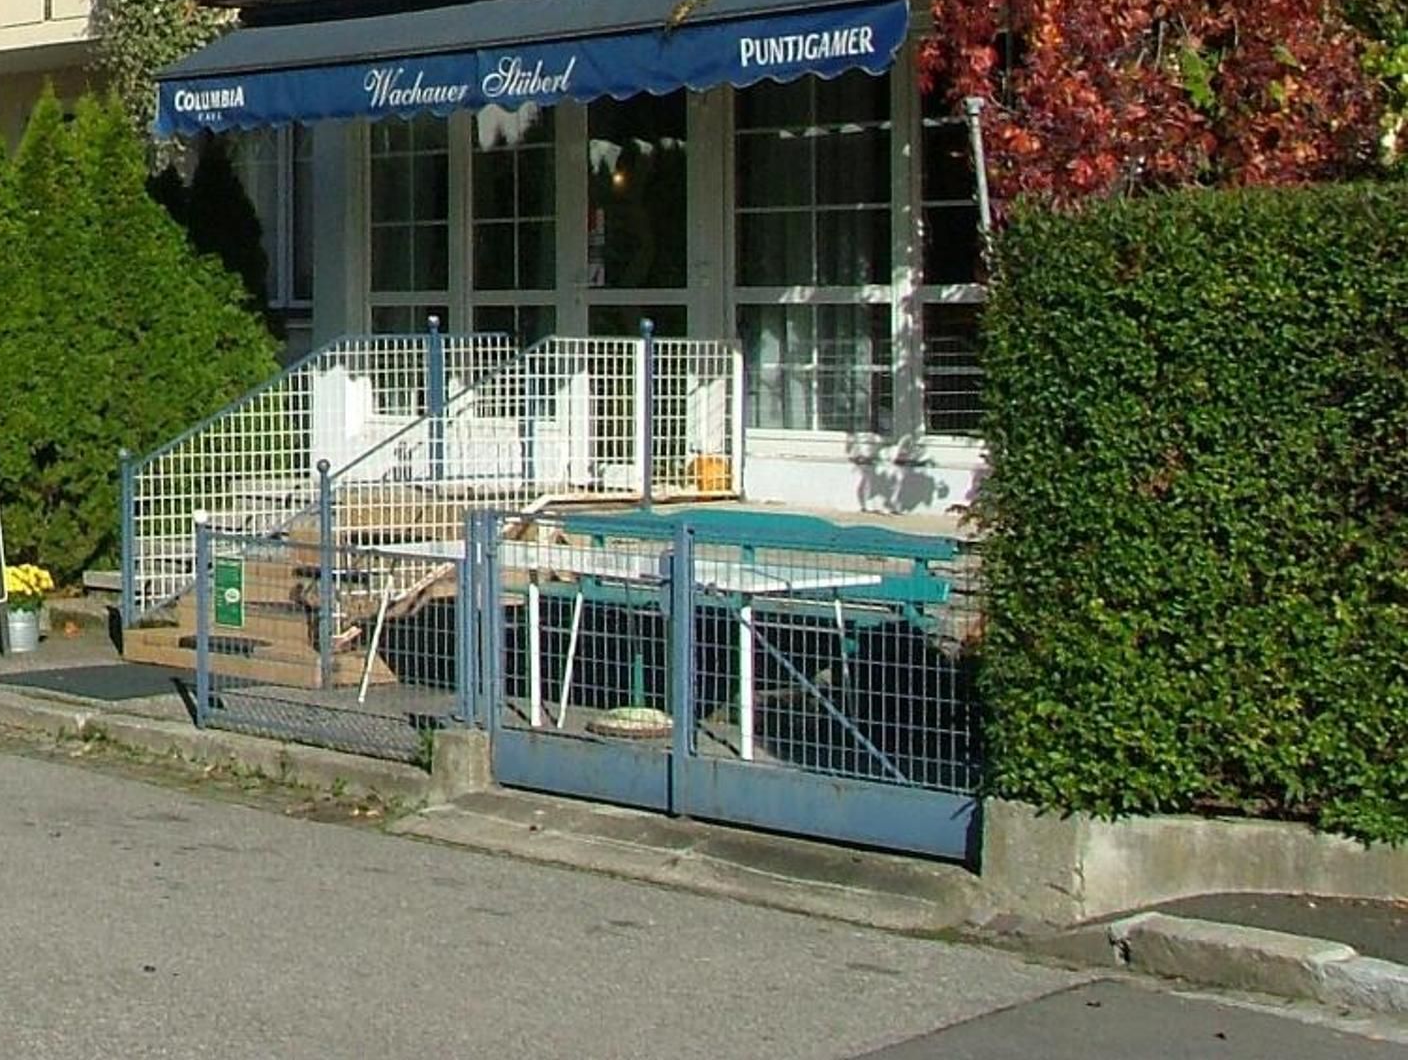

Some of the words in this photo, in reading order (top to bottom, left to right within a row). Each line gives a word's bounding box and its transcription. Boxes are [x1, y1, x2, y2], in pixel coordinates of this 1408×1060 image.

[740, 26, 875, 67] PUNTIGAMER
[174, 86, 245, 112] COLUMBIA
[364, 67, 468, 108] Wachauer
[482, 55, 577, 98] Stüberl
